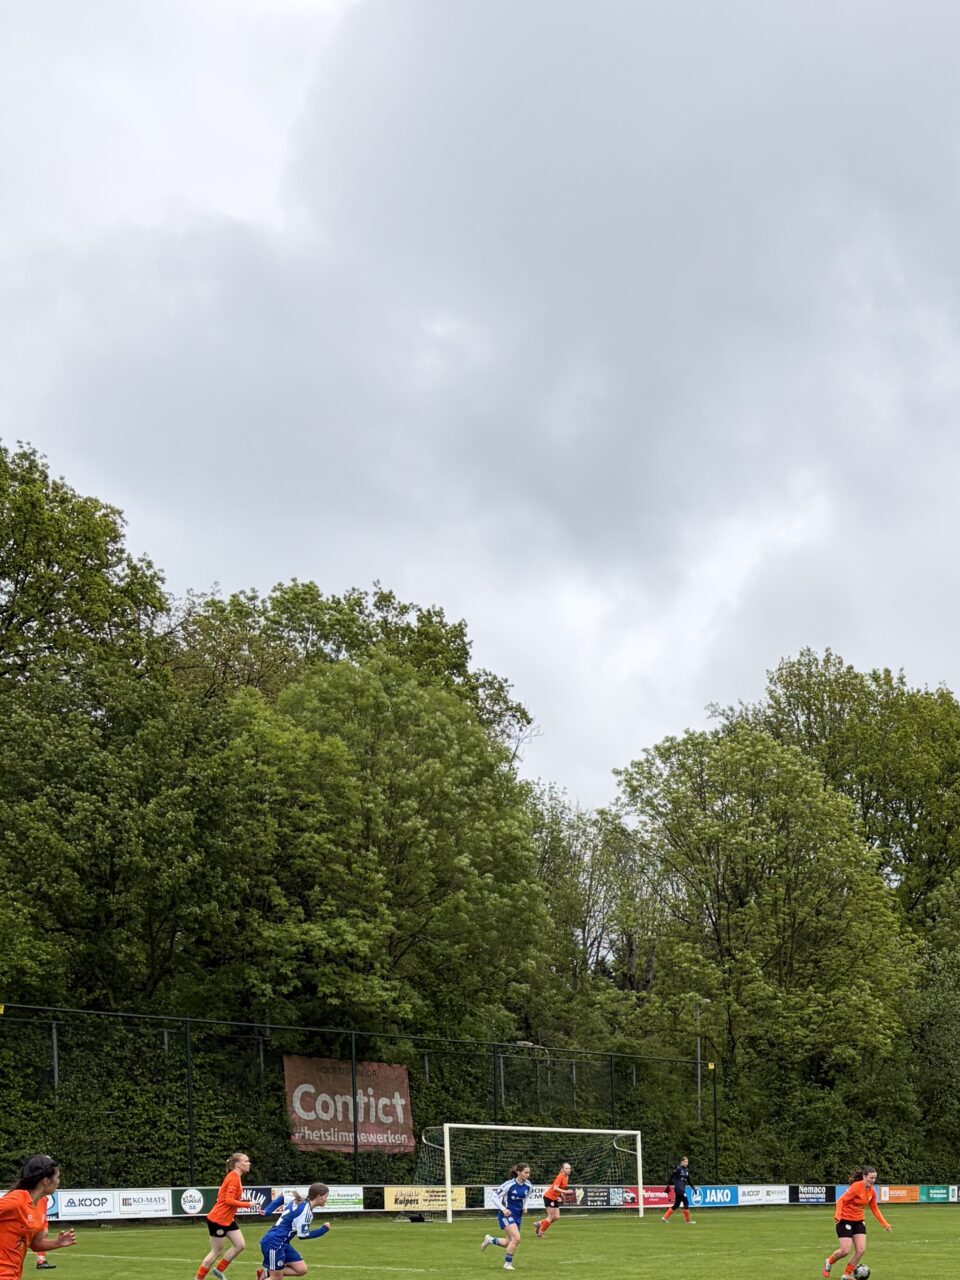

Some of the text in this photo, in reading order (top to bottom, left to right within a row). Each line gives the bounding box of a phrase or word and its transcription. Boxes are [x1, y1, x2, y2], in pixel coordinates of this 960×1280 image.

[293, 1083, 406, 1124] Contict
[798, 1185, 826, 1194] Nemaco
[705, 1189, 731, 1203] JAKO
[78, 1197, 108, 1207] KOOP
[394, 1197, 419, 1207] Kuipers
